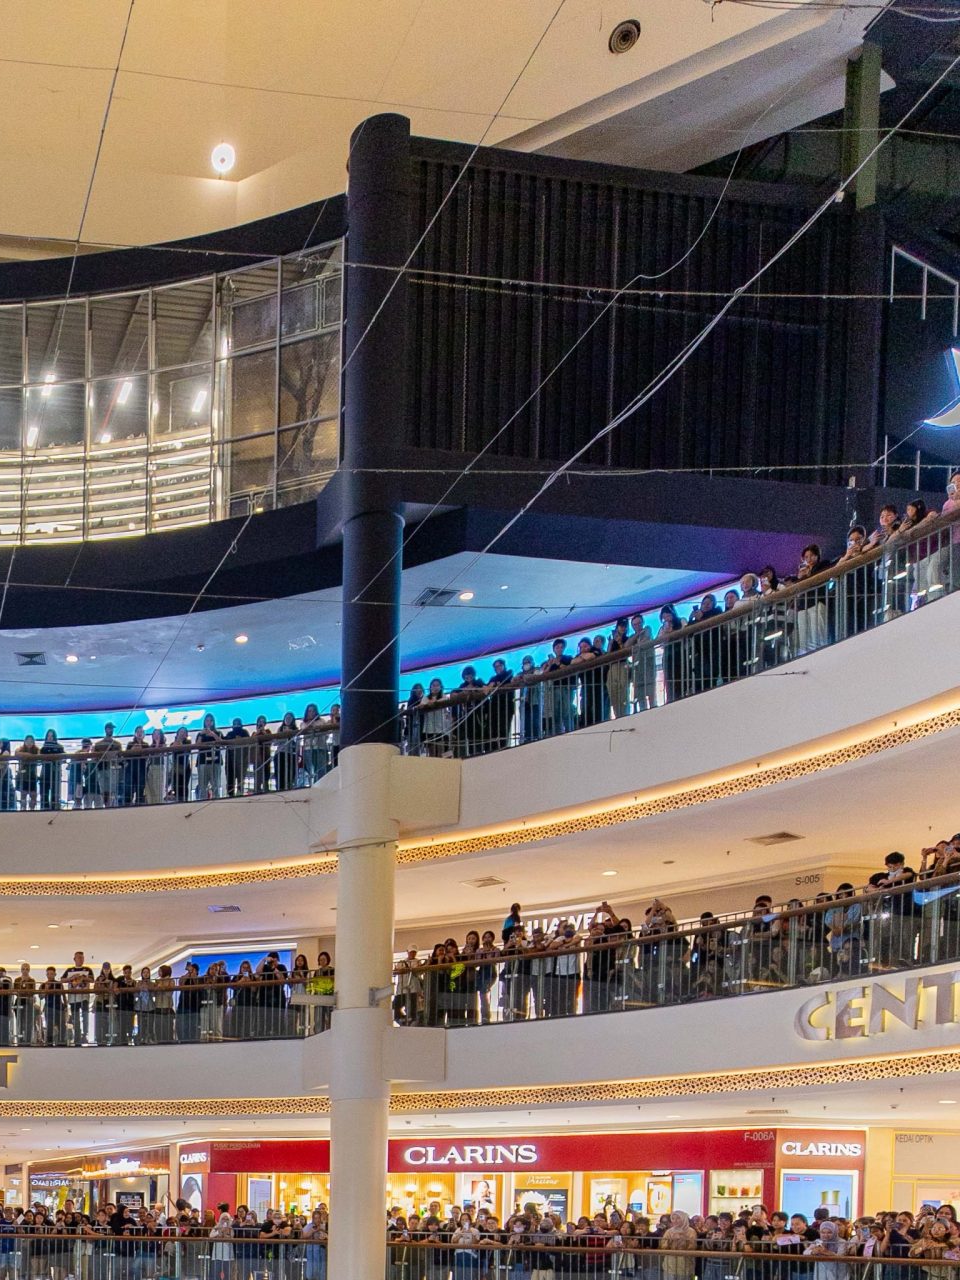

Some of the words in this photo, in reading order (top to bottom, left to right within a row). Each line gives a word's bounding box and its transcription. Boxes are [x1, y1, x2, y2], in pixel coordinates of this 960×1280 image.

[795, 874, 820, 886] S-005
[744, 1132, 775, 1141] F-006A
[404, 1145, 538, 1165] CLARINS
[781, 1141, 862, 1157] CLARINS
[181, 1152, 207, 1163] CLARINS
